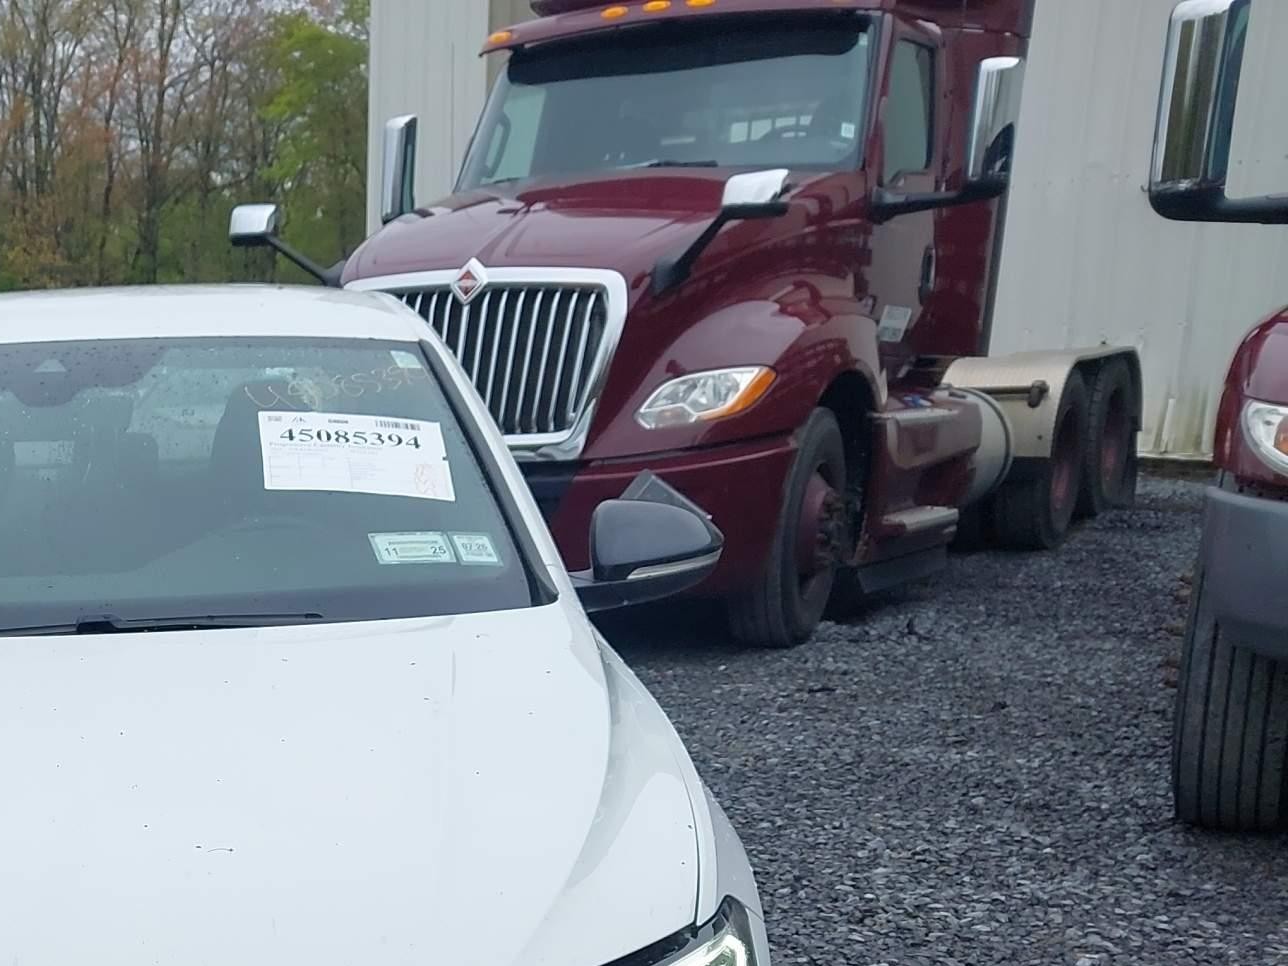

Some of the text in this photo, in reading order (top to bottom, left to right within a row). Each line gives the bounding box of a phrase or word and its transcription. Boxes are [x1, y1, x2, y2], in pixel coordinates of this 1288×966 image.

[279, 428, 422, 450] 45085394
[384, 545, 447, 557] 11 25
